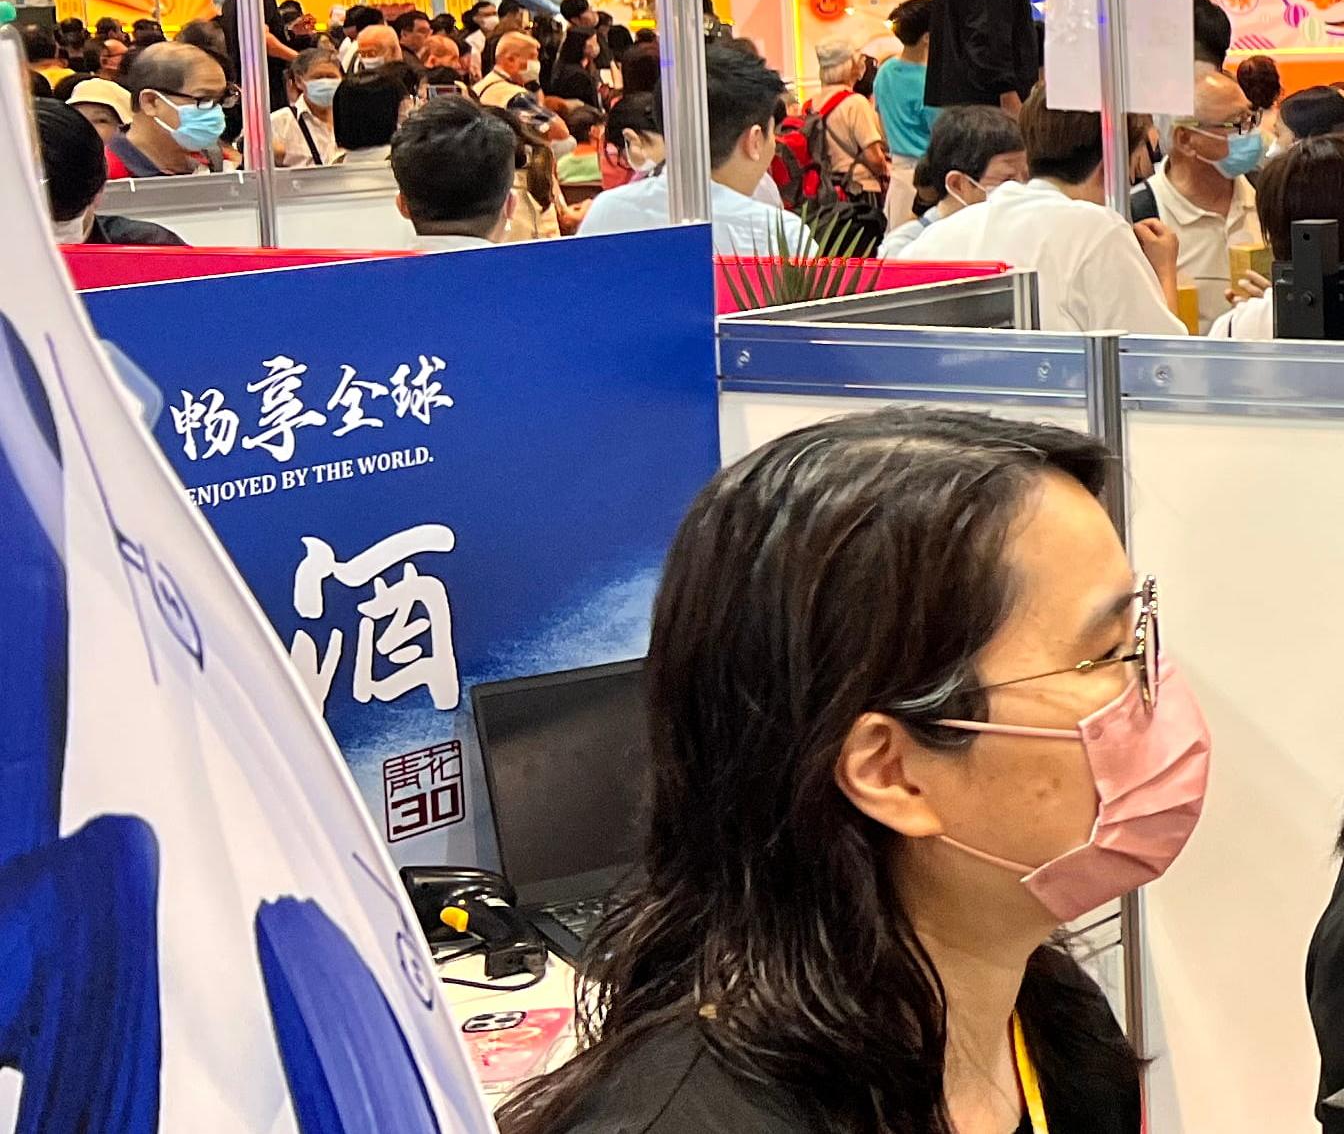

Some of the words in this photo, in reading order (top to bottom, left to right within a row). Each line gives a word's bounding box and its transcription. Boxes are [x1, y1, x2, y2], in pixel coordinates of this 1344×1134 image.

[169, 354, 455, 463] 畅享全球
[185, 473, 277, 507] ENJOYED
[282, 467, 309, 491] BY
[312, 460, 354, 483] THE
[357, 446, 435, 475] WORLD.
[290, 523, 461, 711] 酒
[391, 783, 461, 835] 30
